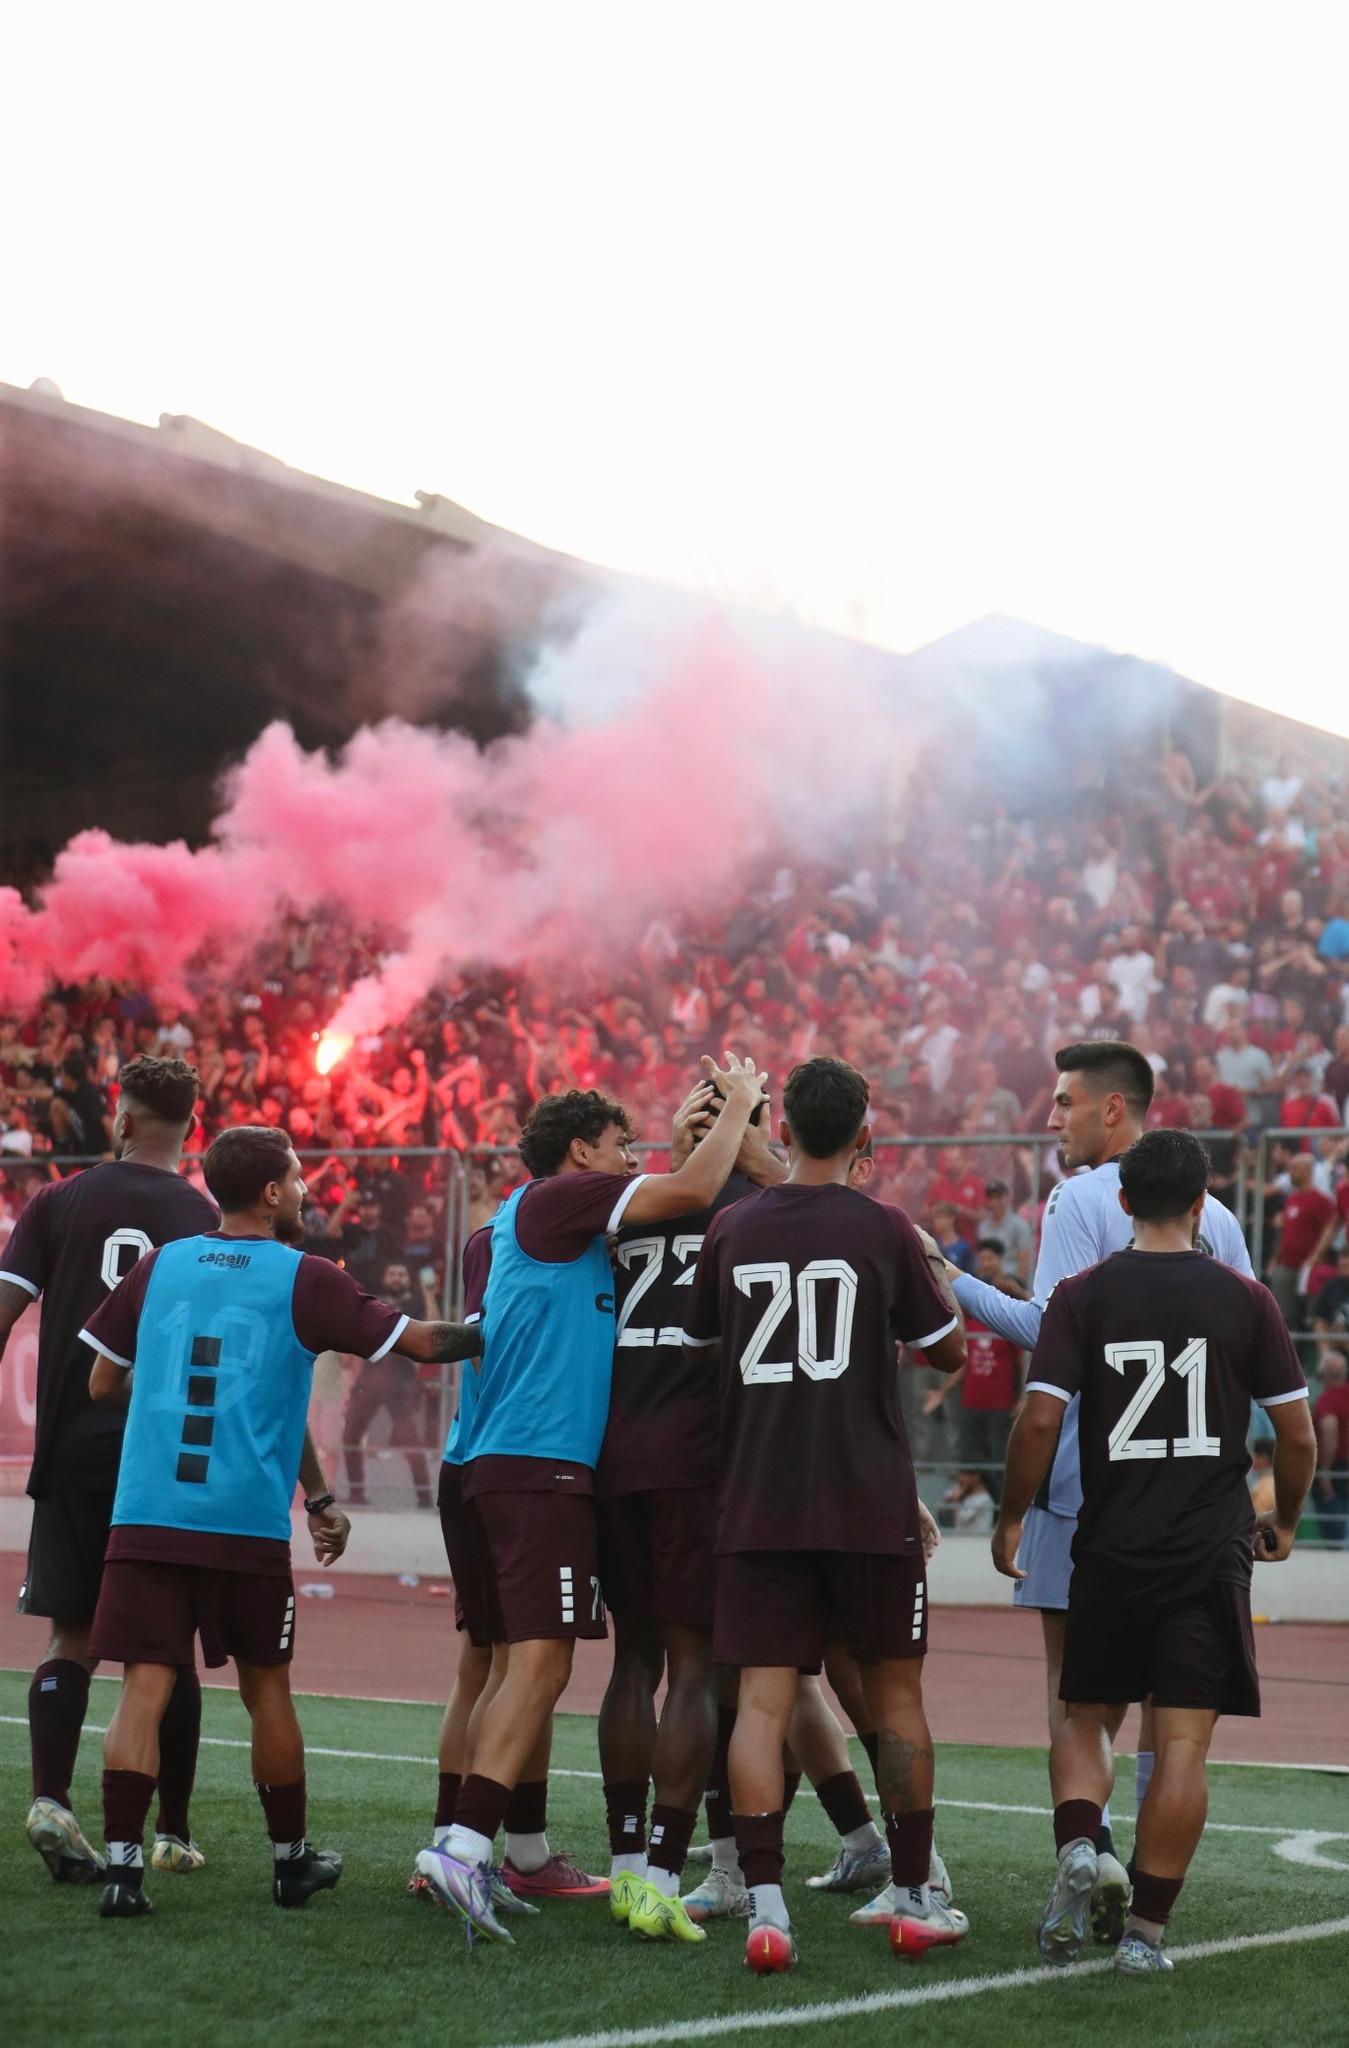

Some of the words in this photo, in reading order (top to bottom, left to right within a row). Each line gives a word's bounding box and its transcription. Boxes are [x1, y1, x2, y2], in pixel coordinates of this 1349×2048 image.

[198, 1252, 252, 1265] capelli
[218, 1261, 248, 1270] SPORT
[733, 1259, 858, 1385] 20
[1104, 1337, 1221, 1461] 21
[748, 1892, 757, 1919] NIKE
[908, 1886, 923, 1905] IKE
